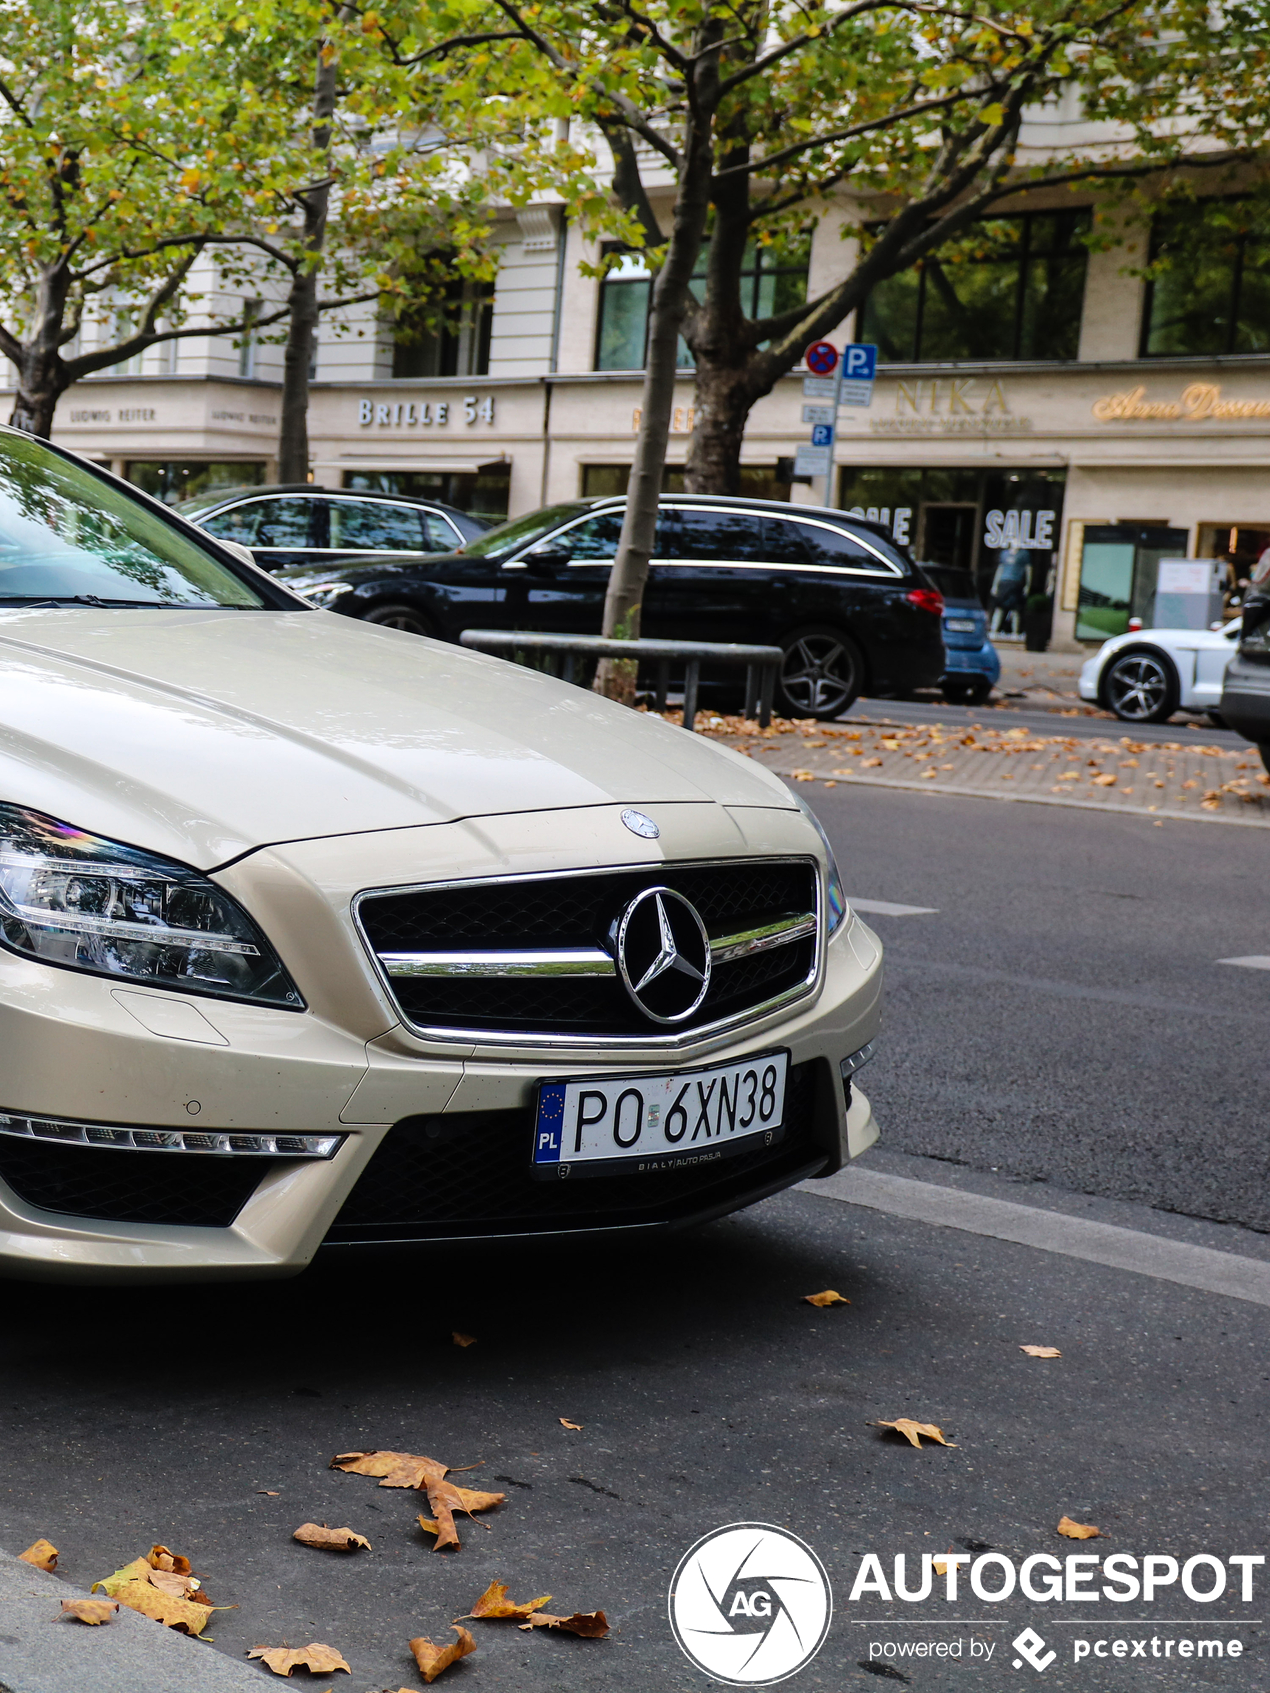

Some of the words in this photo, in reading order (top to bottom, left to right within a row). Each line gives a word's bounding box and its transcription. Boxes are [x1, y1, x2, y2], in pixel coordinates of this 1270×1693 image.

[846, 348, 867, 376] P
[358, 398, 449, 425] BRILLE
[463, 396, 495, 424] 54
[895, 379, 1011, 415] NIKA
[70, 409, 111, 423] LUDWIG
[118, 408, 156, 422] REITER
[984, 509, 1056, 549] SALE
[574, 1088, 644, 1153] PO
[664, 1064, 777, 1144] 6XN38
[539, 1132, 558, 1150] PL
